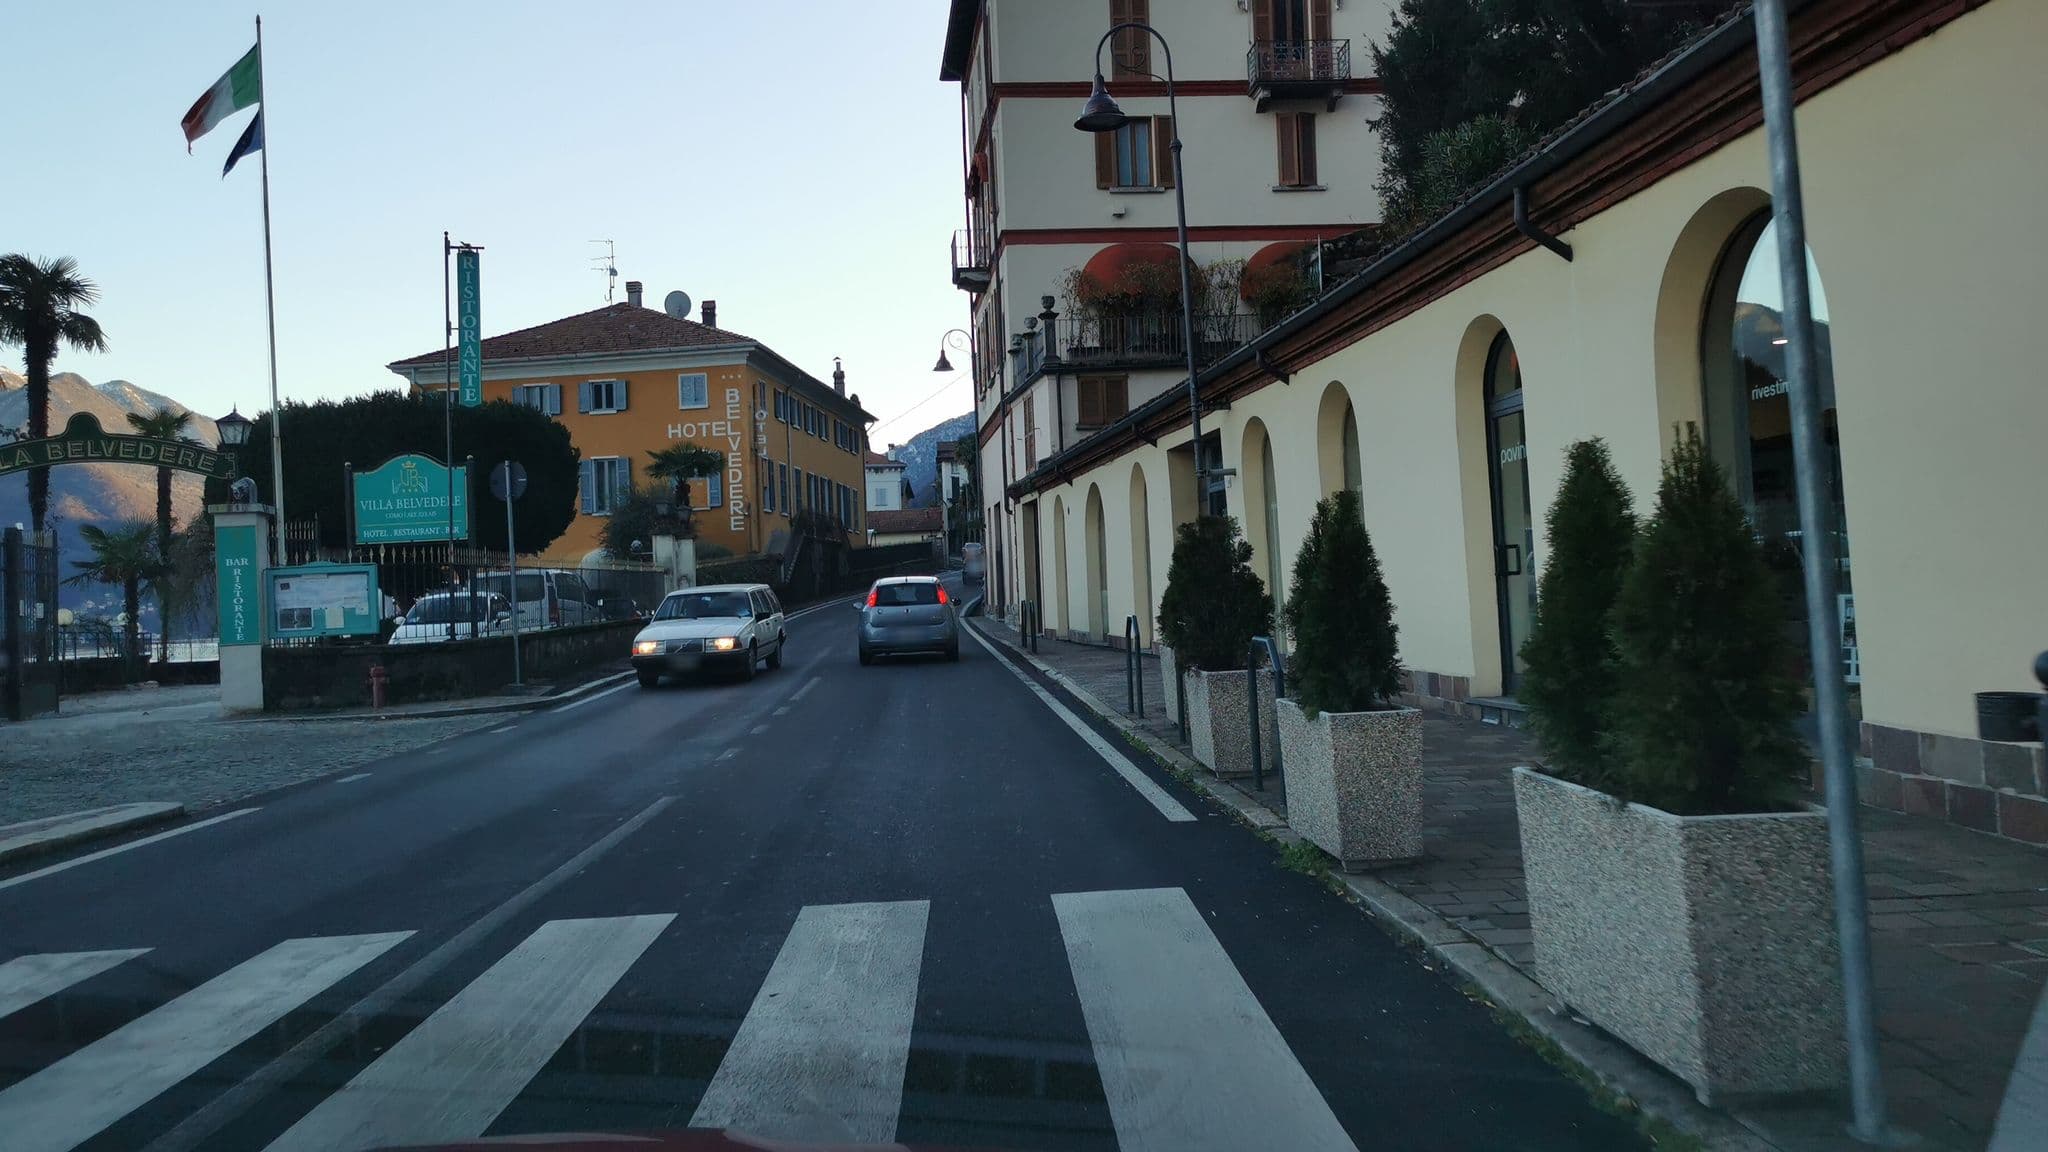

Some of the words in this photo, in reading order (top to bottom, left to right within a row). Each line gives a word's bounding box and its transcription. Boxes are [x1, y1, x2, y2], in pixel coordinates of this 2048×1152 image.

[463, 256, 477, 401] RISTORANTE
[667, 421, 741, 439] HOTEL
[47, 439, 217, 471] BELVEDERE
[726, 388, 745, 531] BELVEDERE
[360, 500, 393, 511] VILLA
[364, 529, 387, 538] HOTEL
[393, 527, 440, 537] RESTAURANT
[445, 526, 460, 534] BR
[226, 558, 248, 567] BAR
[233, 568, 244, 641] RISTORANTE
